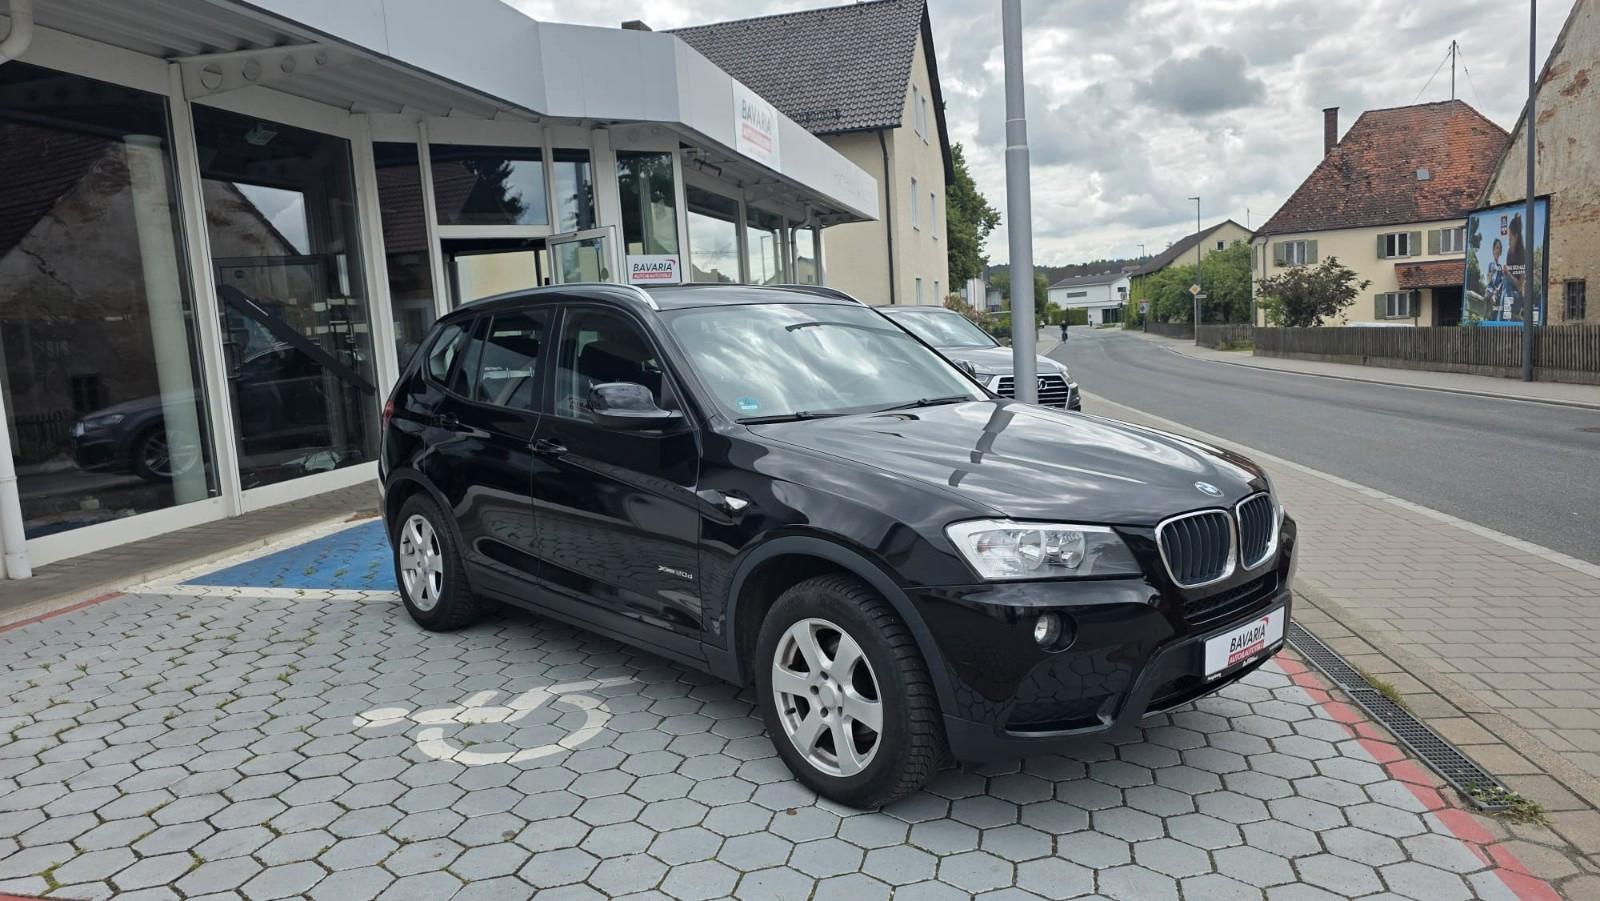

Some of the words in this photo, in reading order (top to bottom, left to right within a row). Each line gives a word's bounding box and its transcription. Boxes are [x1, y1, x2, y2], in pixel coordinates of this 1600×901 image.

[742, 99, 770, 132] BAVARIA
[633, 263, 673, 272] BAVARIA
[1229, 624, 1266, 652] BAVARIA
